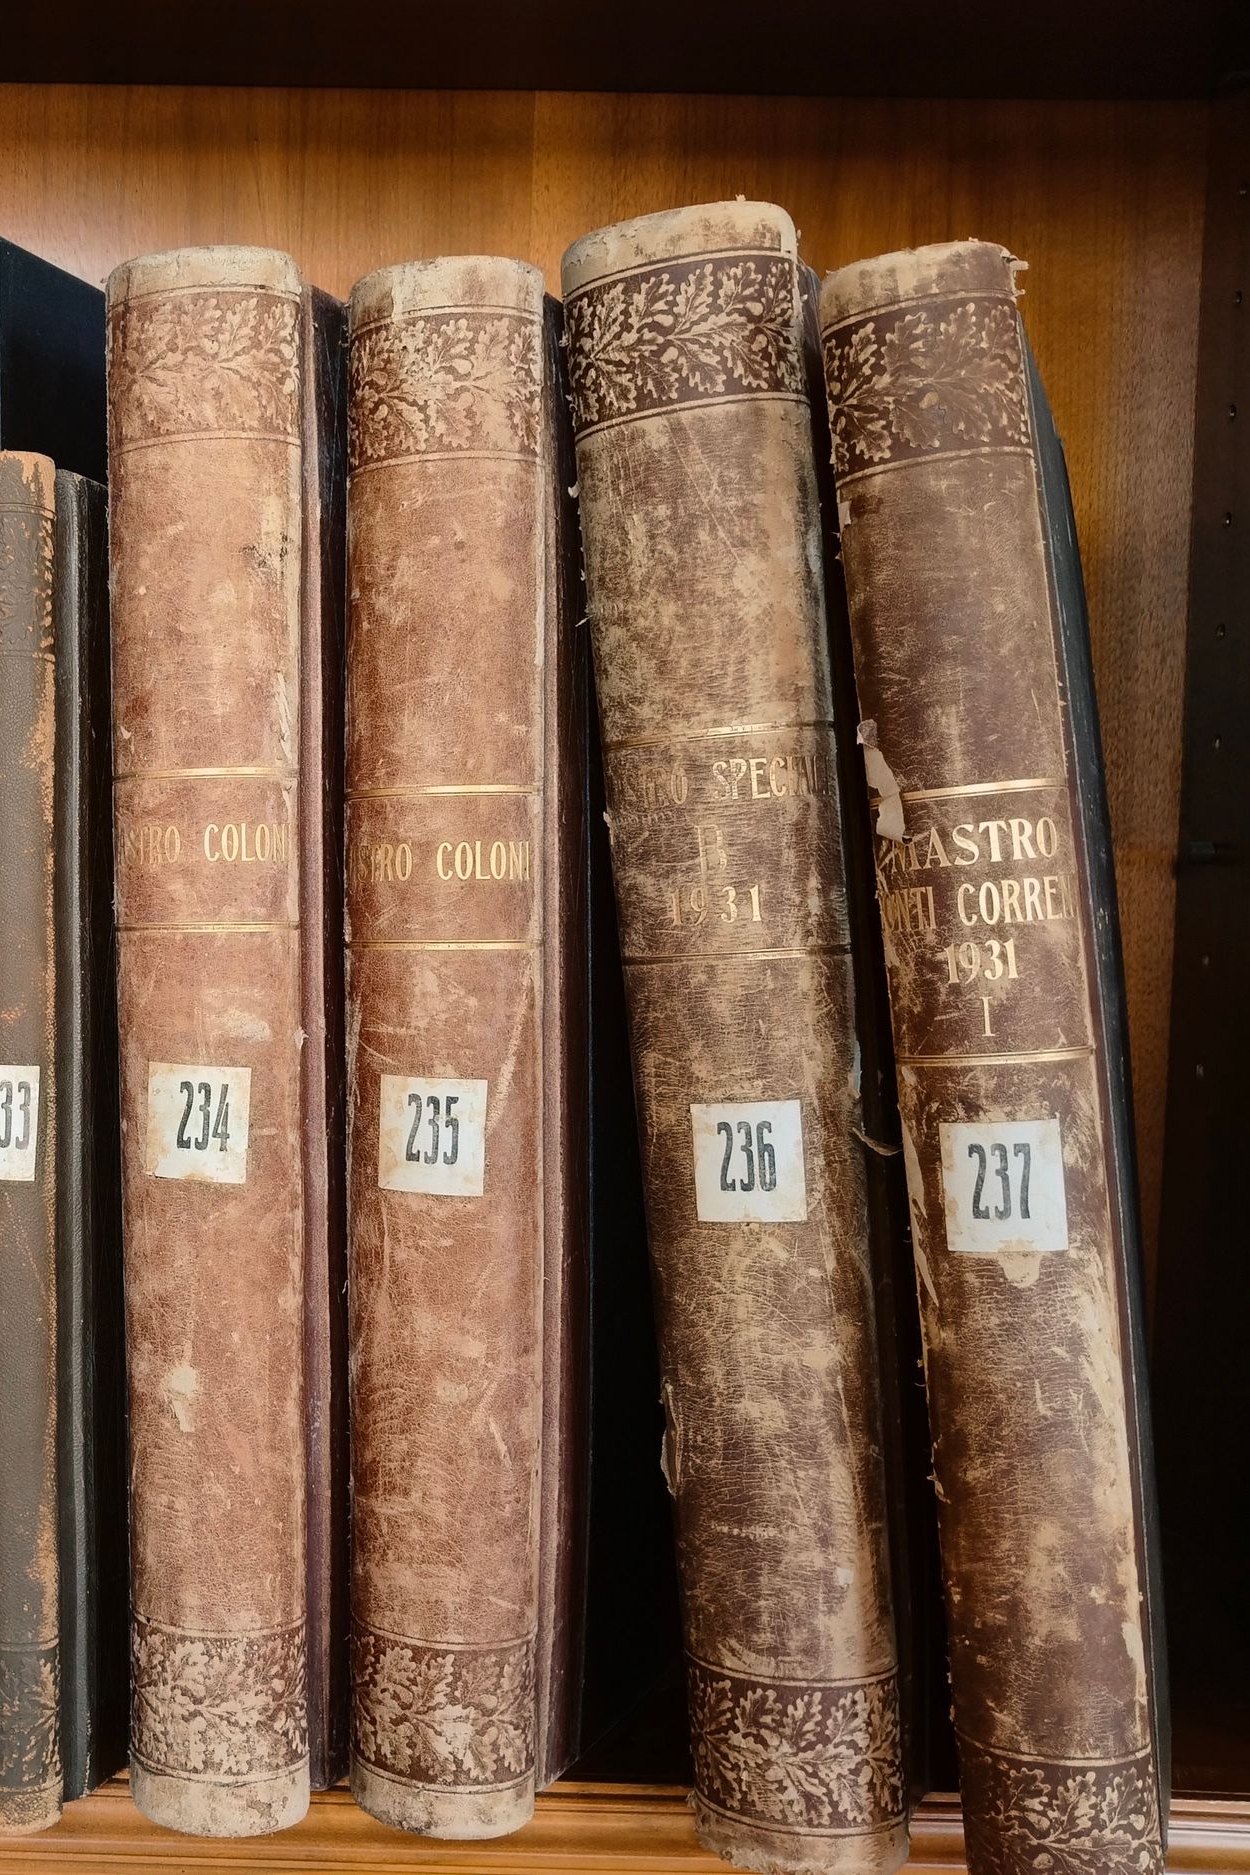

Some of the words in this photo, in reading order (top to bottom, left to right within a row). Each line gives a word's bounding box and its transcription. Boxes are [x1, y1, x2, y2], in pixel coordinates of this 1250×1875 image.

[944, 938, 1020, 985] 1931
[979, 996, 996, 1038] I
[176, 1080, 231, 1152] 234
[405, 1092, 461, 1165] 235
[717, 1120, 777, 1192] 236
[966, 1142, 1033, 1221] 237
